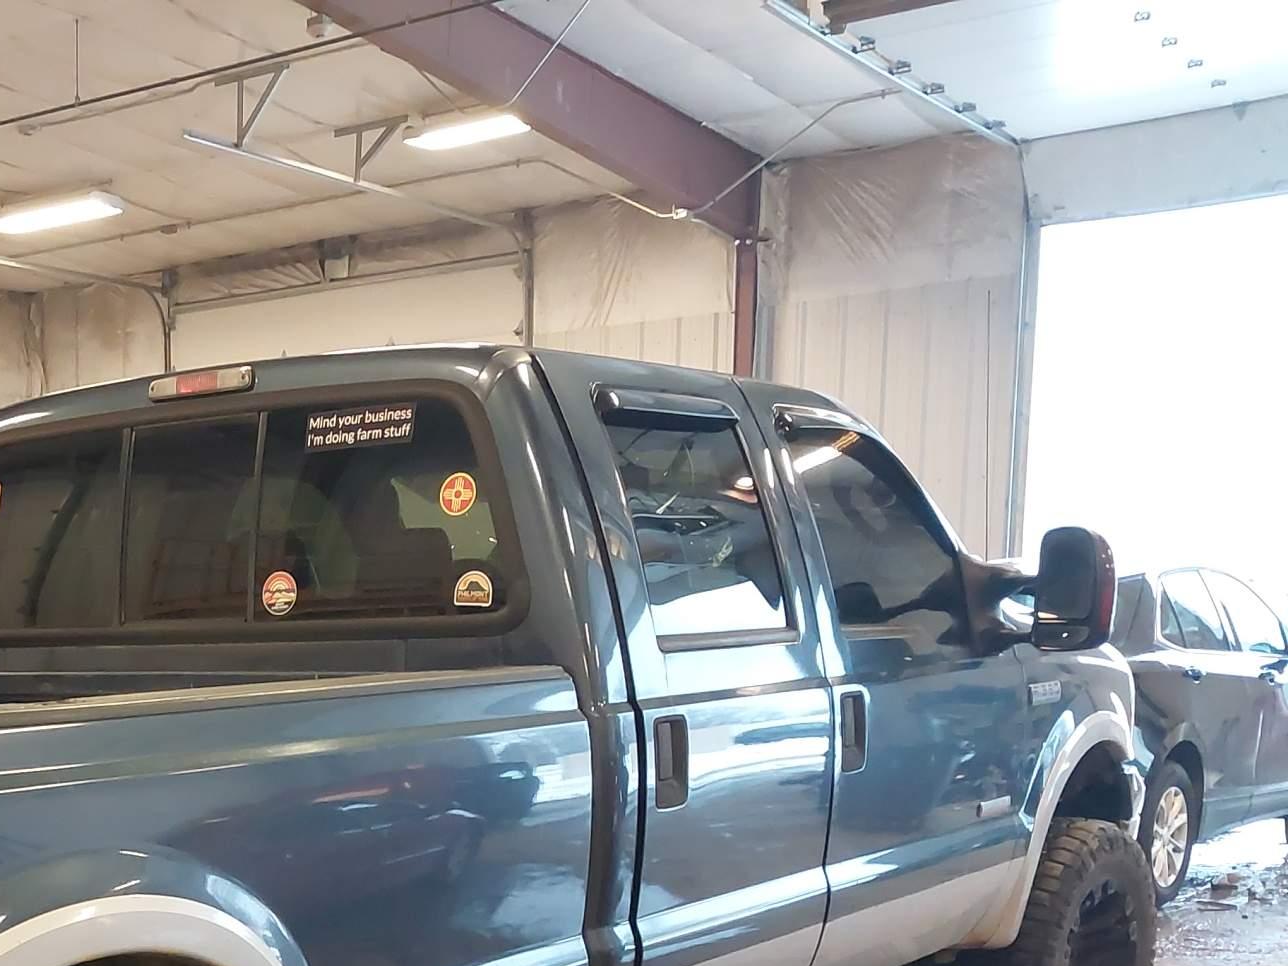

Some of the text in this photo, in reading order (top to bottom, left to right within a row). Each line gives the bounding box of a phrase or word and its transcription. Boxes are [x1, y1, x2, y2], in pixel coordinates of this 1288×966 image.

[309, 407, 412, 431] Mind your business
[307, 423, 412, 448] I'm doing farm stuff
